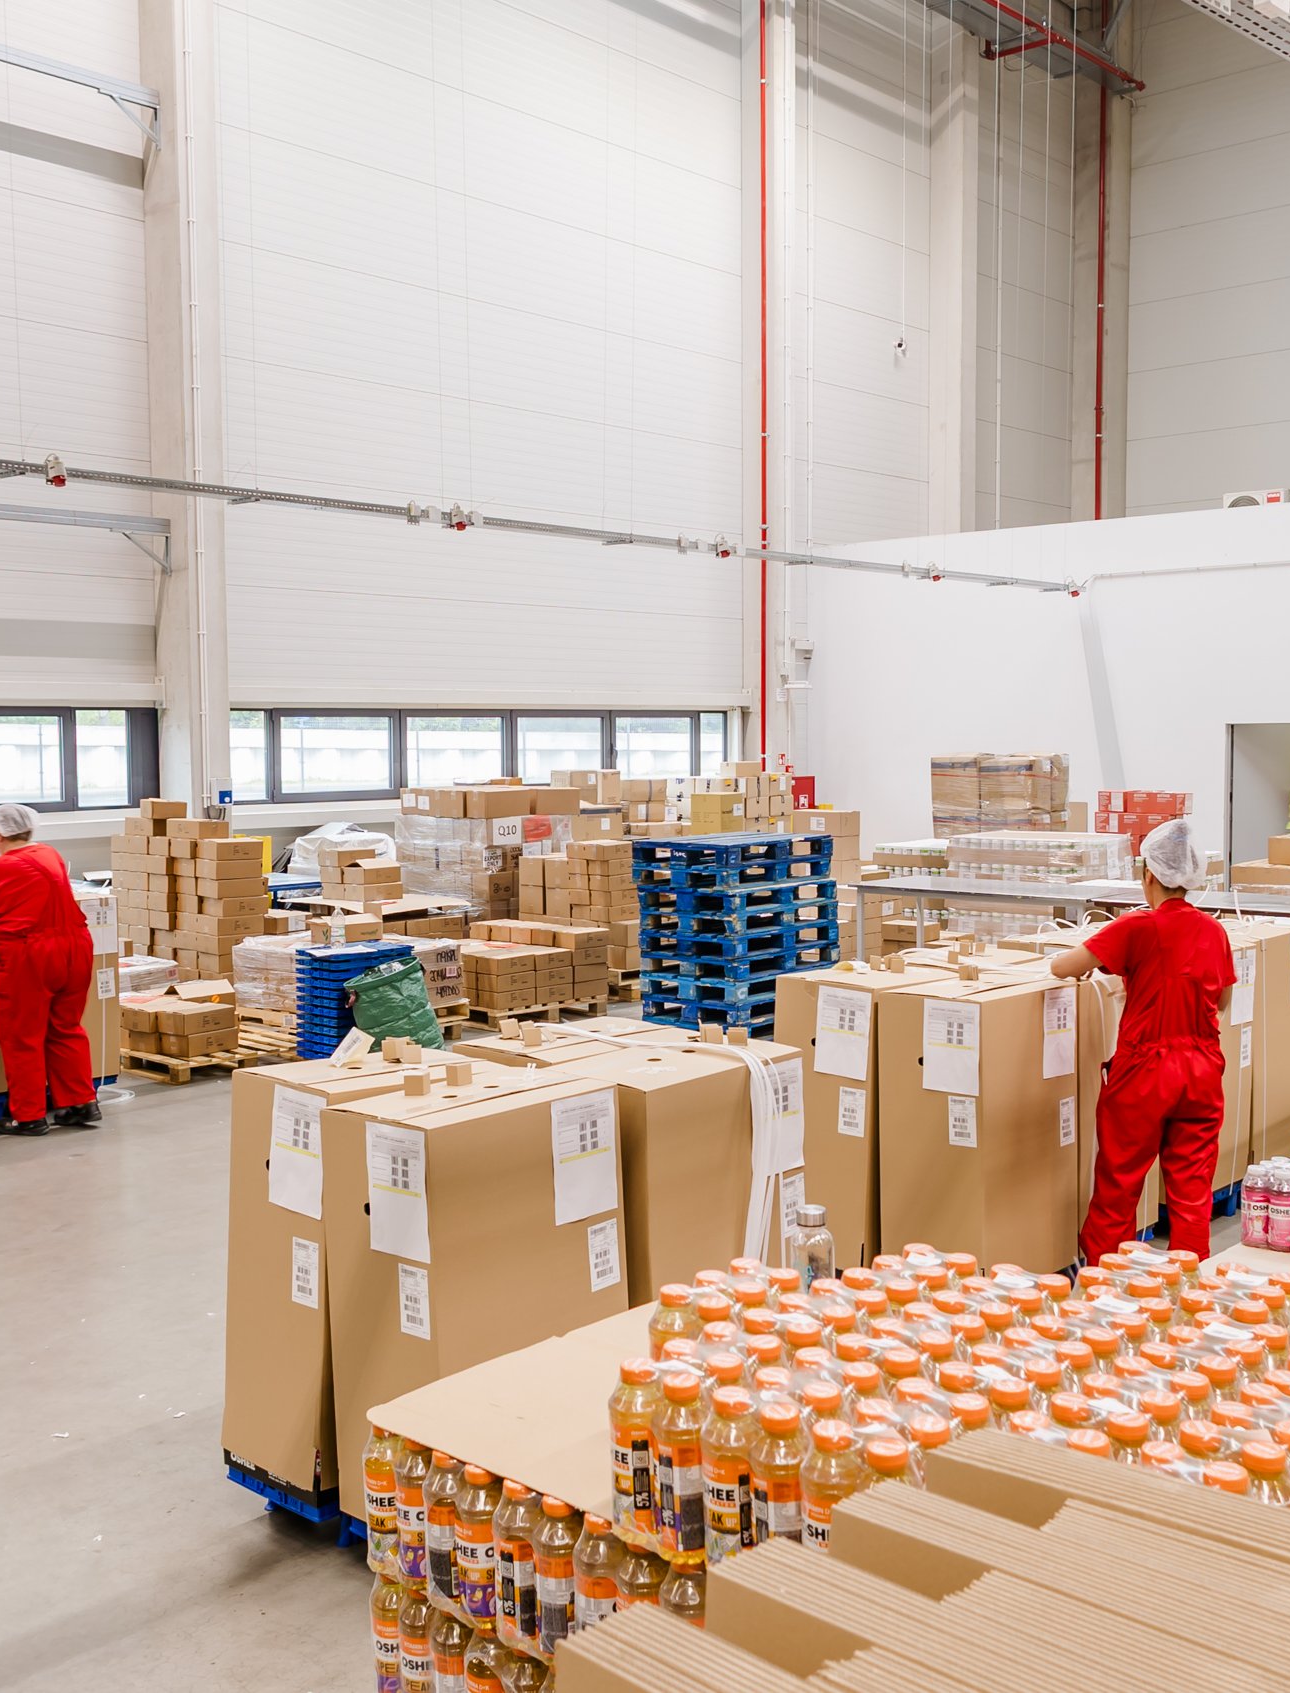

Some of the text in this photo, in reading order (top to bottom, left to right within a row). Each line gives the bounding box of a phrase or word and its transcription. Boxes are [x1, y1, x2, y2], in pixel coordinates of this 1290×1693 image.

[498, 825, 517, 837] Q10
[367, 1494, 396, 1508] SHEE
[636, 1492, 649, 1507] 5%
[503, 1599, 514, 1615] 5%
